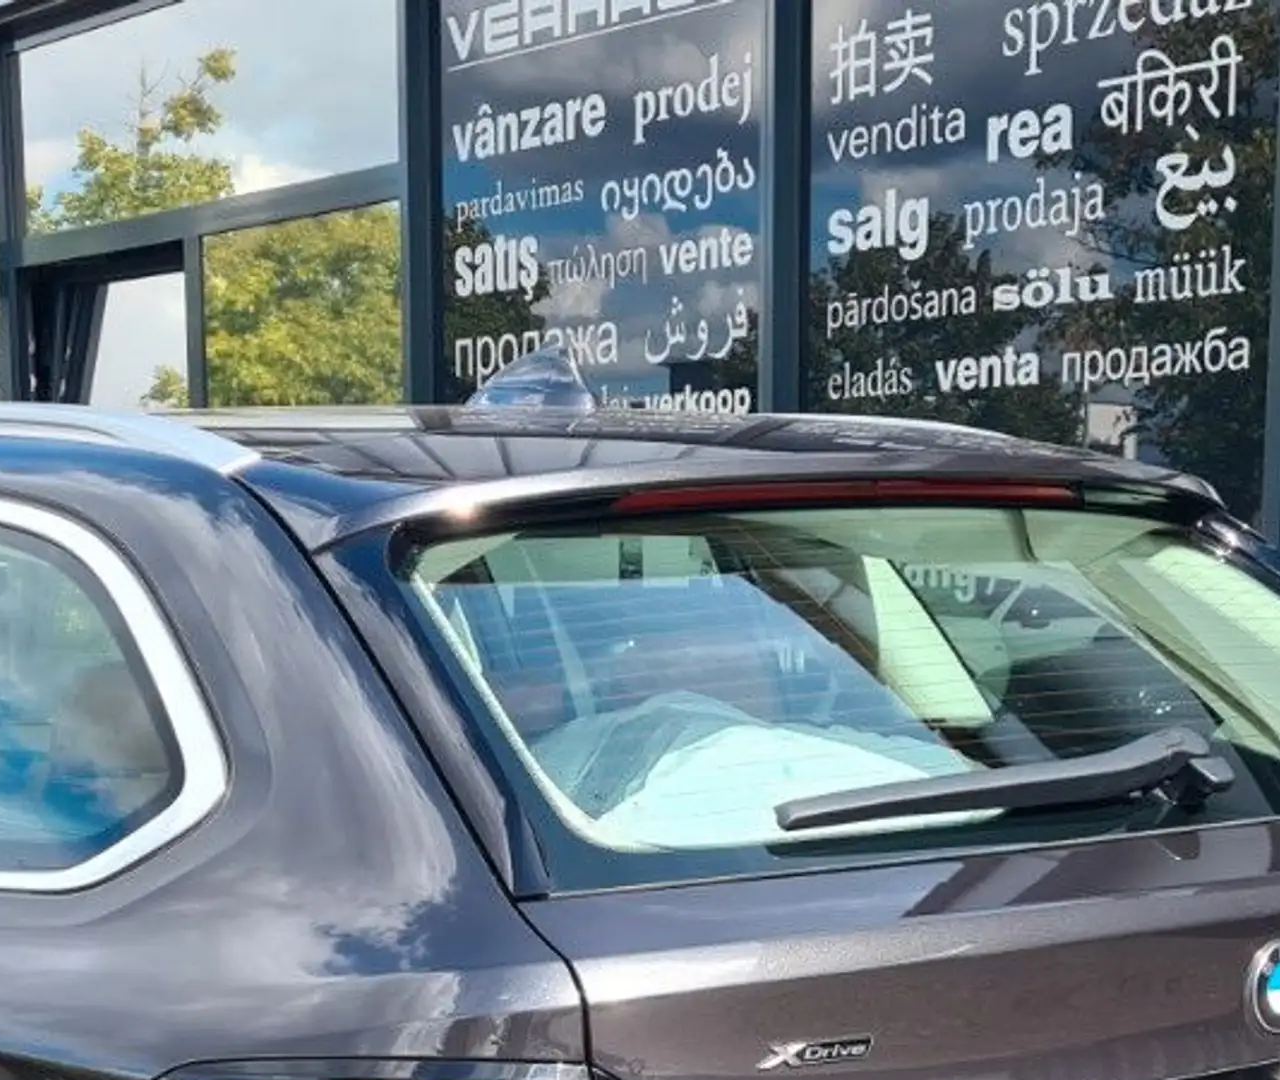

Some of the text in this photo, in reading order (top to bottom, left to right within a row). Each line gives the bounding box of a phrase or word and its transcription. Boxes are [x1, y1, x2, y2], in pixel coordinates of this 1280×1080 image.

[829, 9, 934, 104] 拍卖
[453, 52, 753, 162] vânzare prodej
[828, 103, 1073, 163] vendita rea
[457, 177, 584, 233] pardavimas
[601, 147, 756, 220] იყიდება
[827, 172, 1104, 260] salg prodaja
[1155, 145, 1238, 230] بيع
[455, 233, 538, 301] satış
[546, 243, 647, 289] πώληση
[658, 227, 754, 274] vente
[644, 287, 748, 364] فروش
[826, 245, 1247, 337] pārdošana sölu müük
[827, 346, 1040, 400] eladás venta
[1062, 328, 1250, 391] продажба
